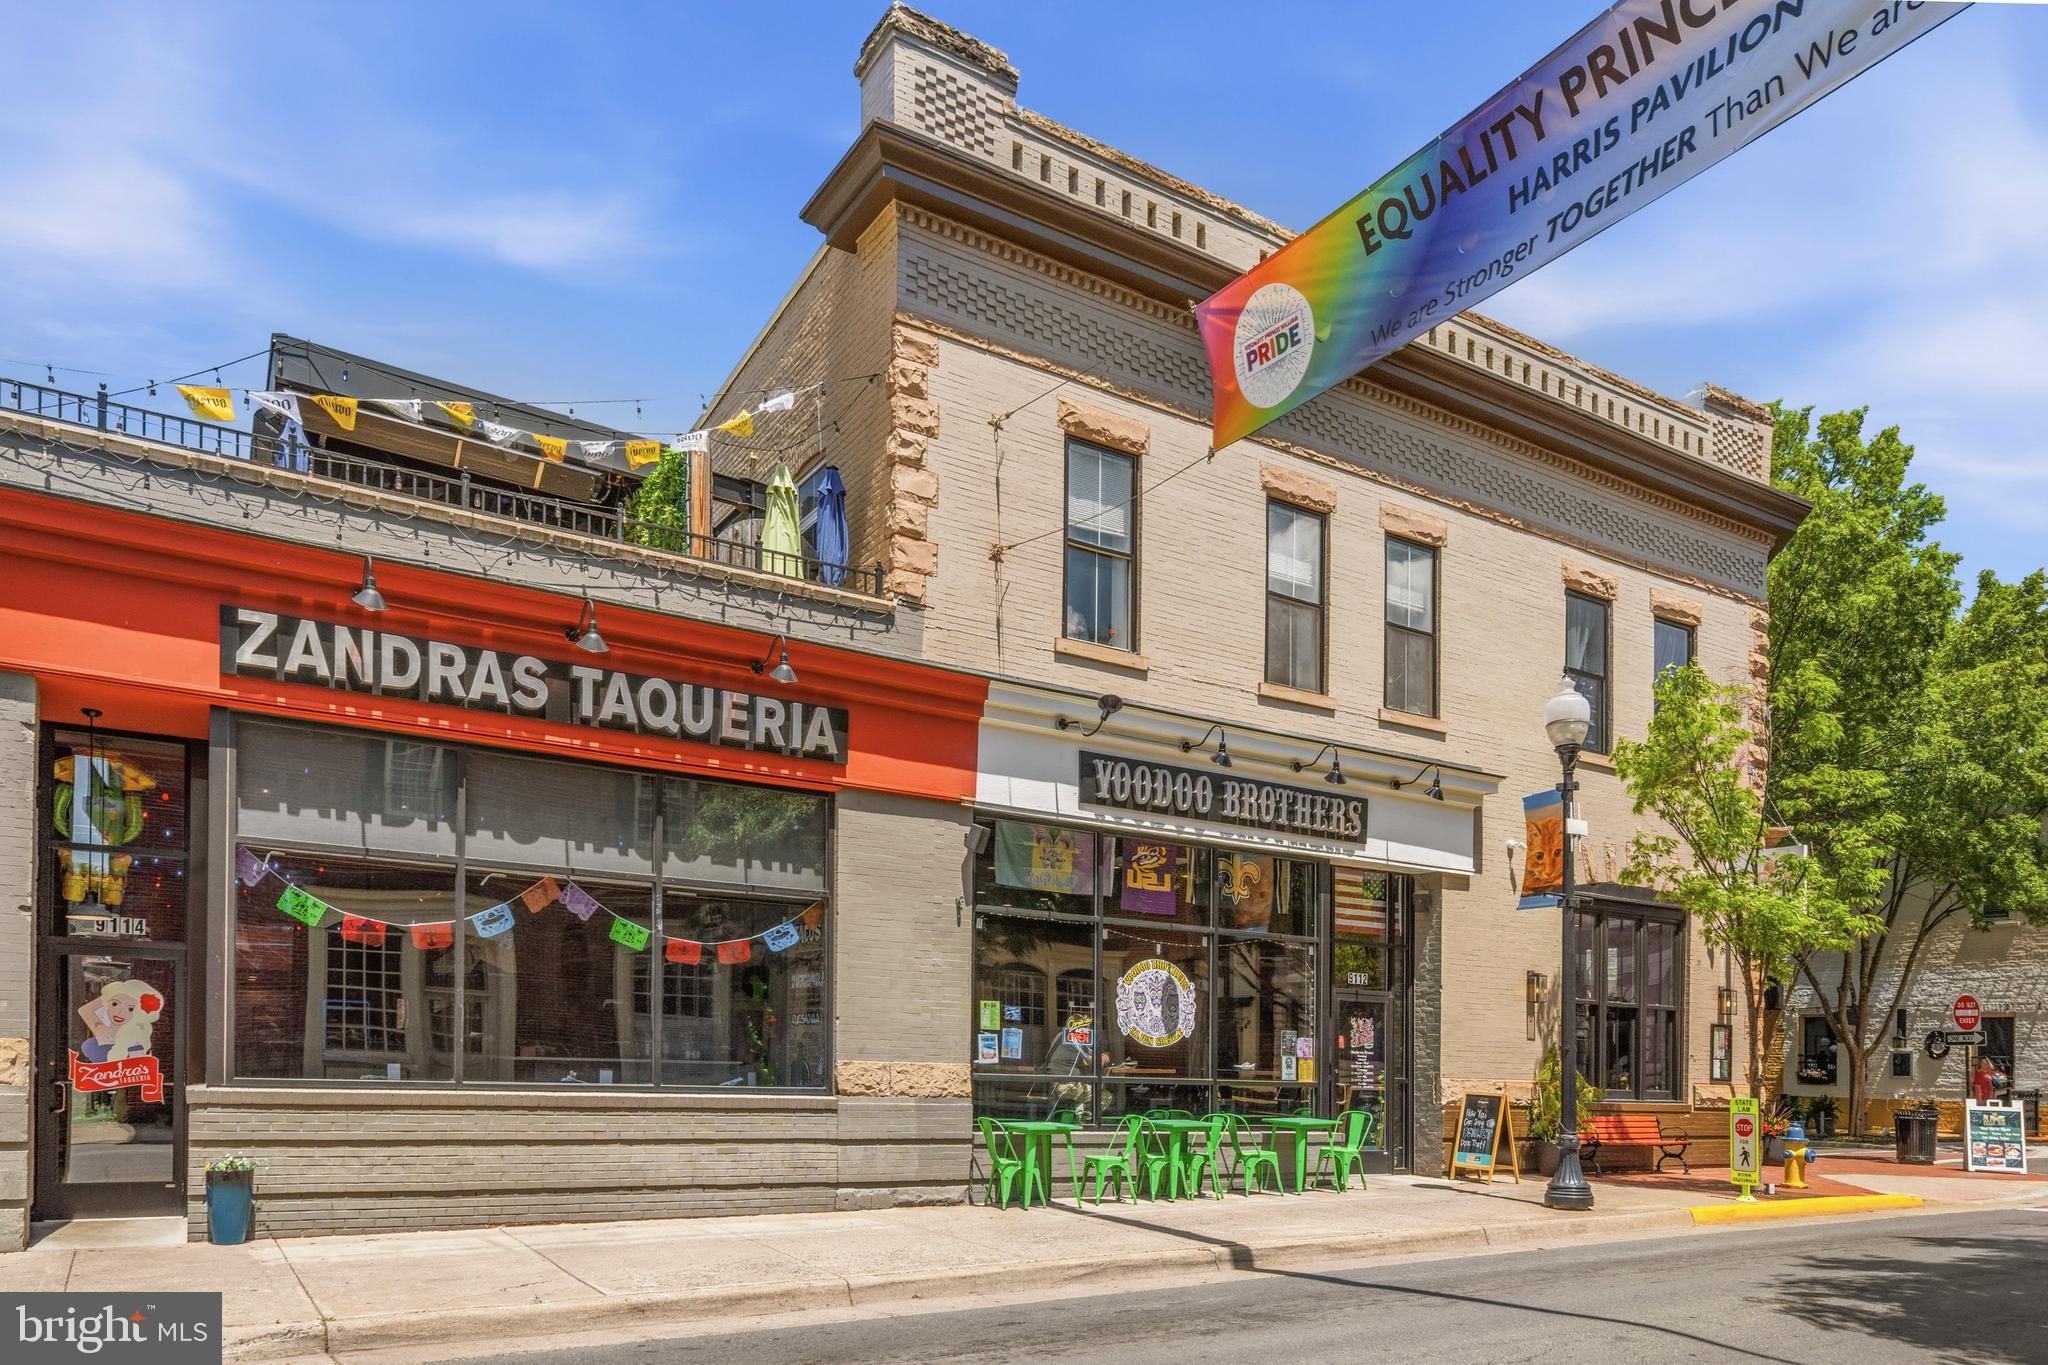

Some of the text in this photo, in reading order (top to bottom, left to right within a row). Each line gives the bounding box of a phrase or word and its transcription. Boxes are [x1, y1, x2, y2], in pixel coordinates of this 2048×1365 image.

[1355, 0, 1739, 256] EQUALITY PRINC
[1508, 0, 1803, 214] HARRIS PAVILION
[1370, 320, 1402, 347] We
[1408, 298, 1438, 328] are
[1444, 233, 1539, 307] Stronger
[1546, 125, 1697, 244] TOGETHER
[1705, 74, 1785, 138] Than
[1794, 28, 1858, 81] We
[1246, 322, 1301, 373] PRIDE
[235, 608, 838, 754] ZANDRAS TAQUERIA
[1092, 758, 1362, 837] VOODOO BROTHERS
[95, 919, 145, 935] 9114
[1348, 973, 1369, 985] 9112
[78, 1061, 149, 1086] Zandra's
[119, 1074, 151, 1084] TAQUERIA
[1736, 1123, 1753, 1132] STOP
